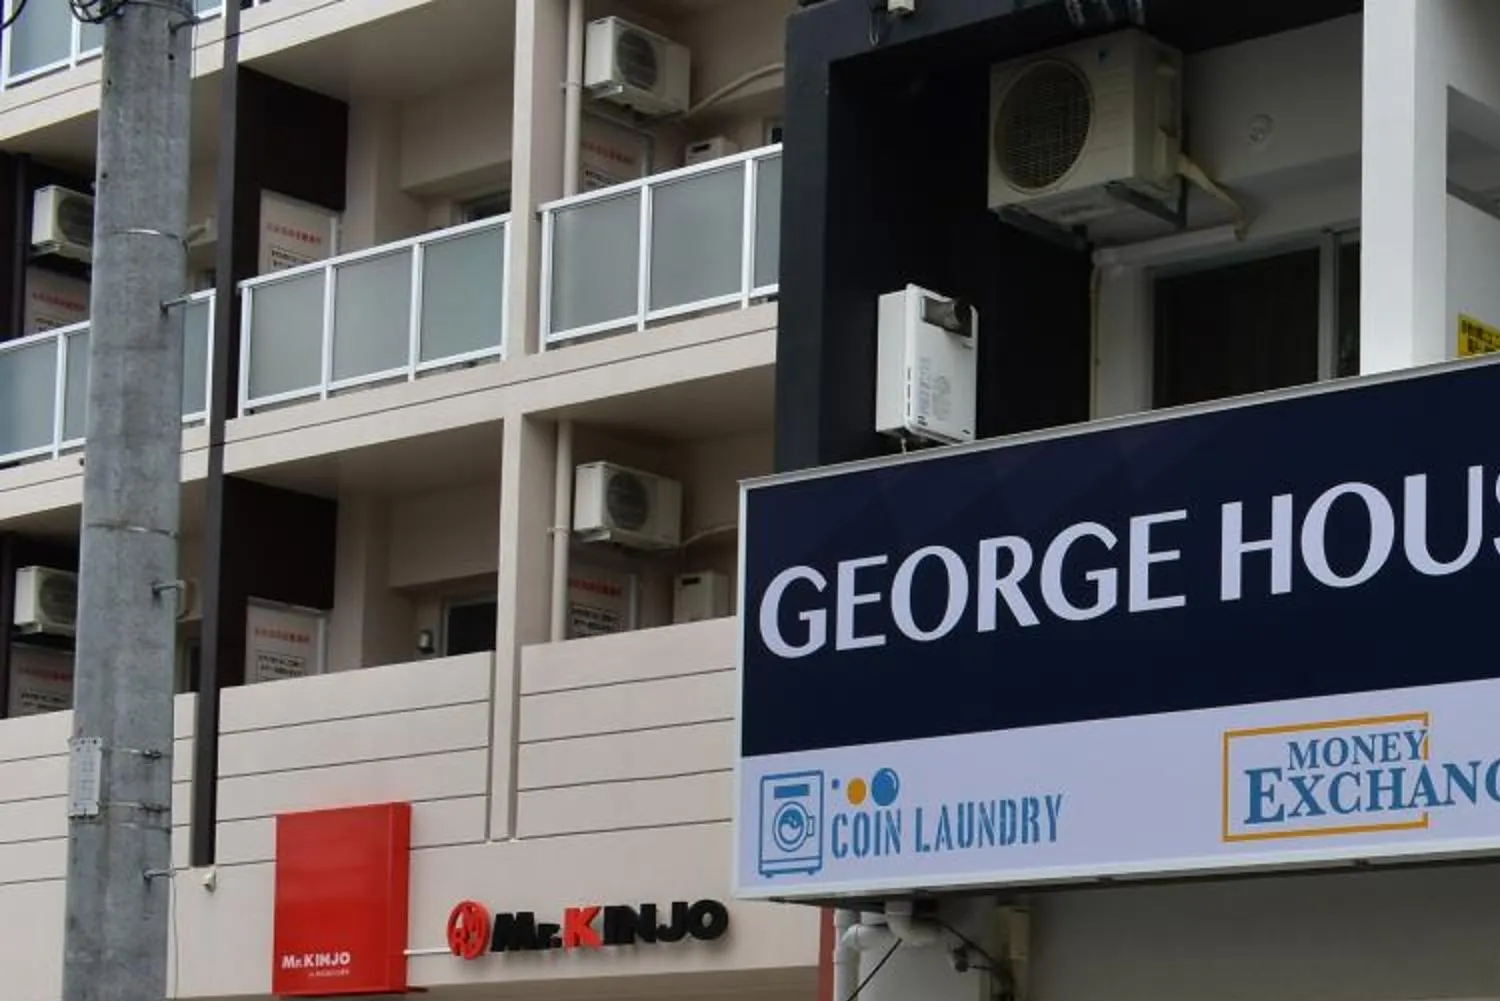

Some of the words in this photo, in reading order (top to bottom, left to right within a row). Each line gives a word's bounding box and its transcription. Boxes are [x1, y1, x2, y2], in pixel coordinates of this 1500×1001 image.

[758, 508, 1188, 659] GEORGE
[1286, 728, 1428, 772] MONEY
[831, 808, 902, 859] COIN
[915, 793, 1063, 853] LAUNDRY
